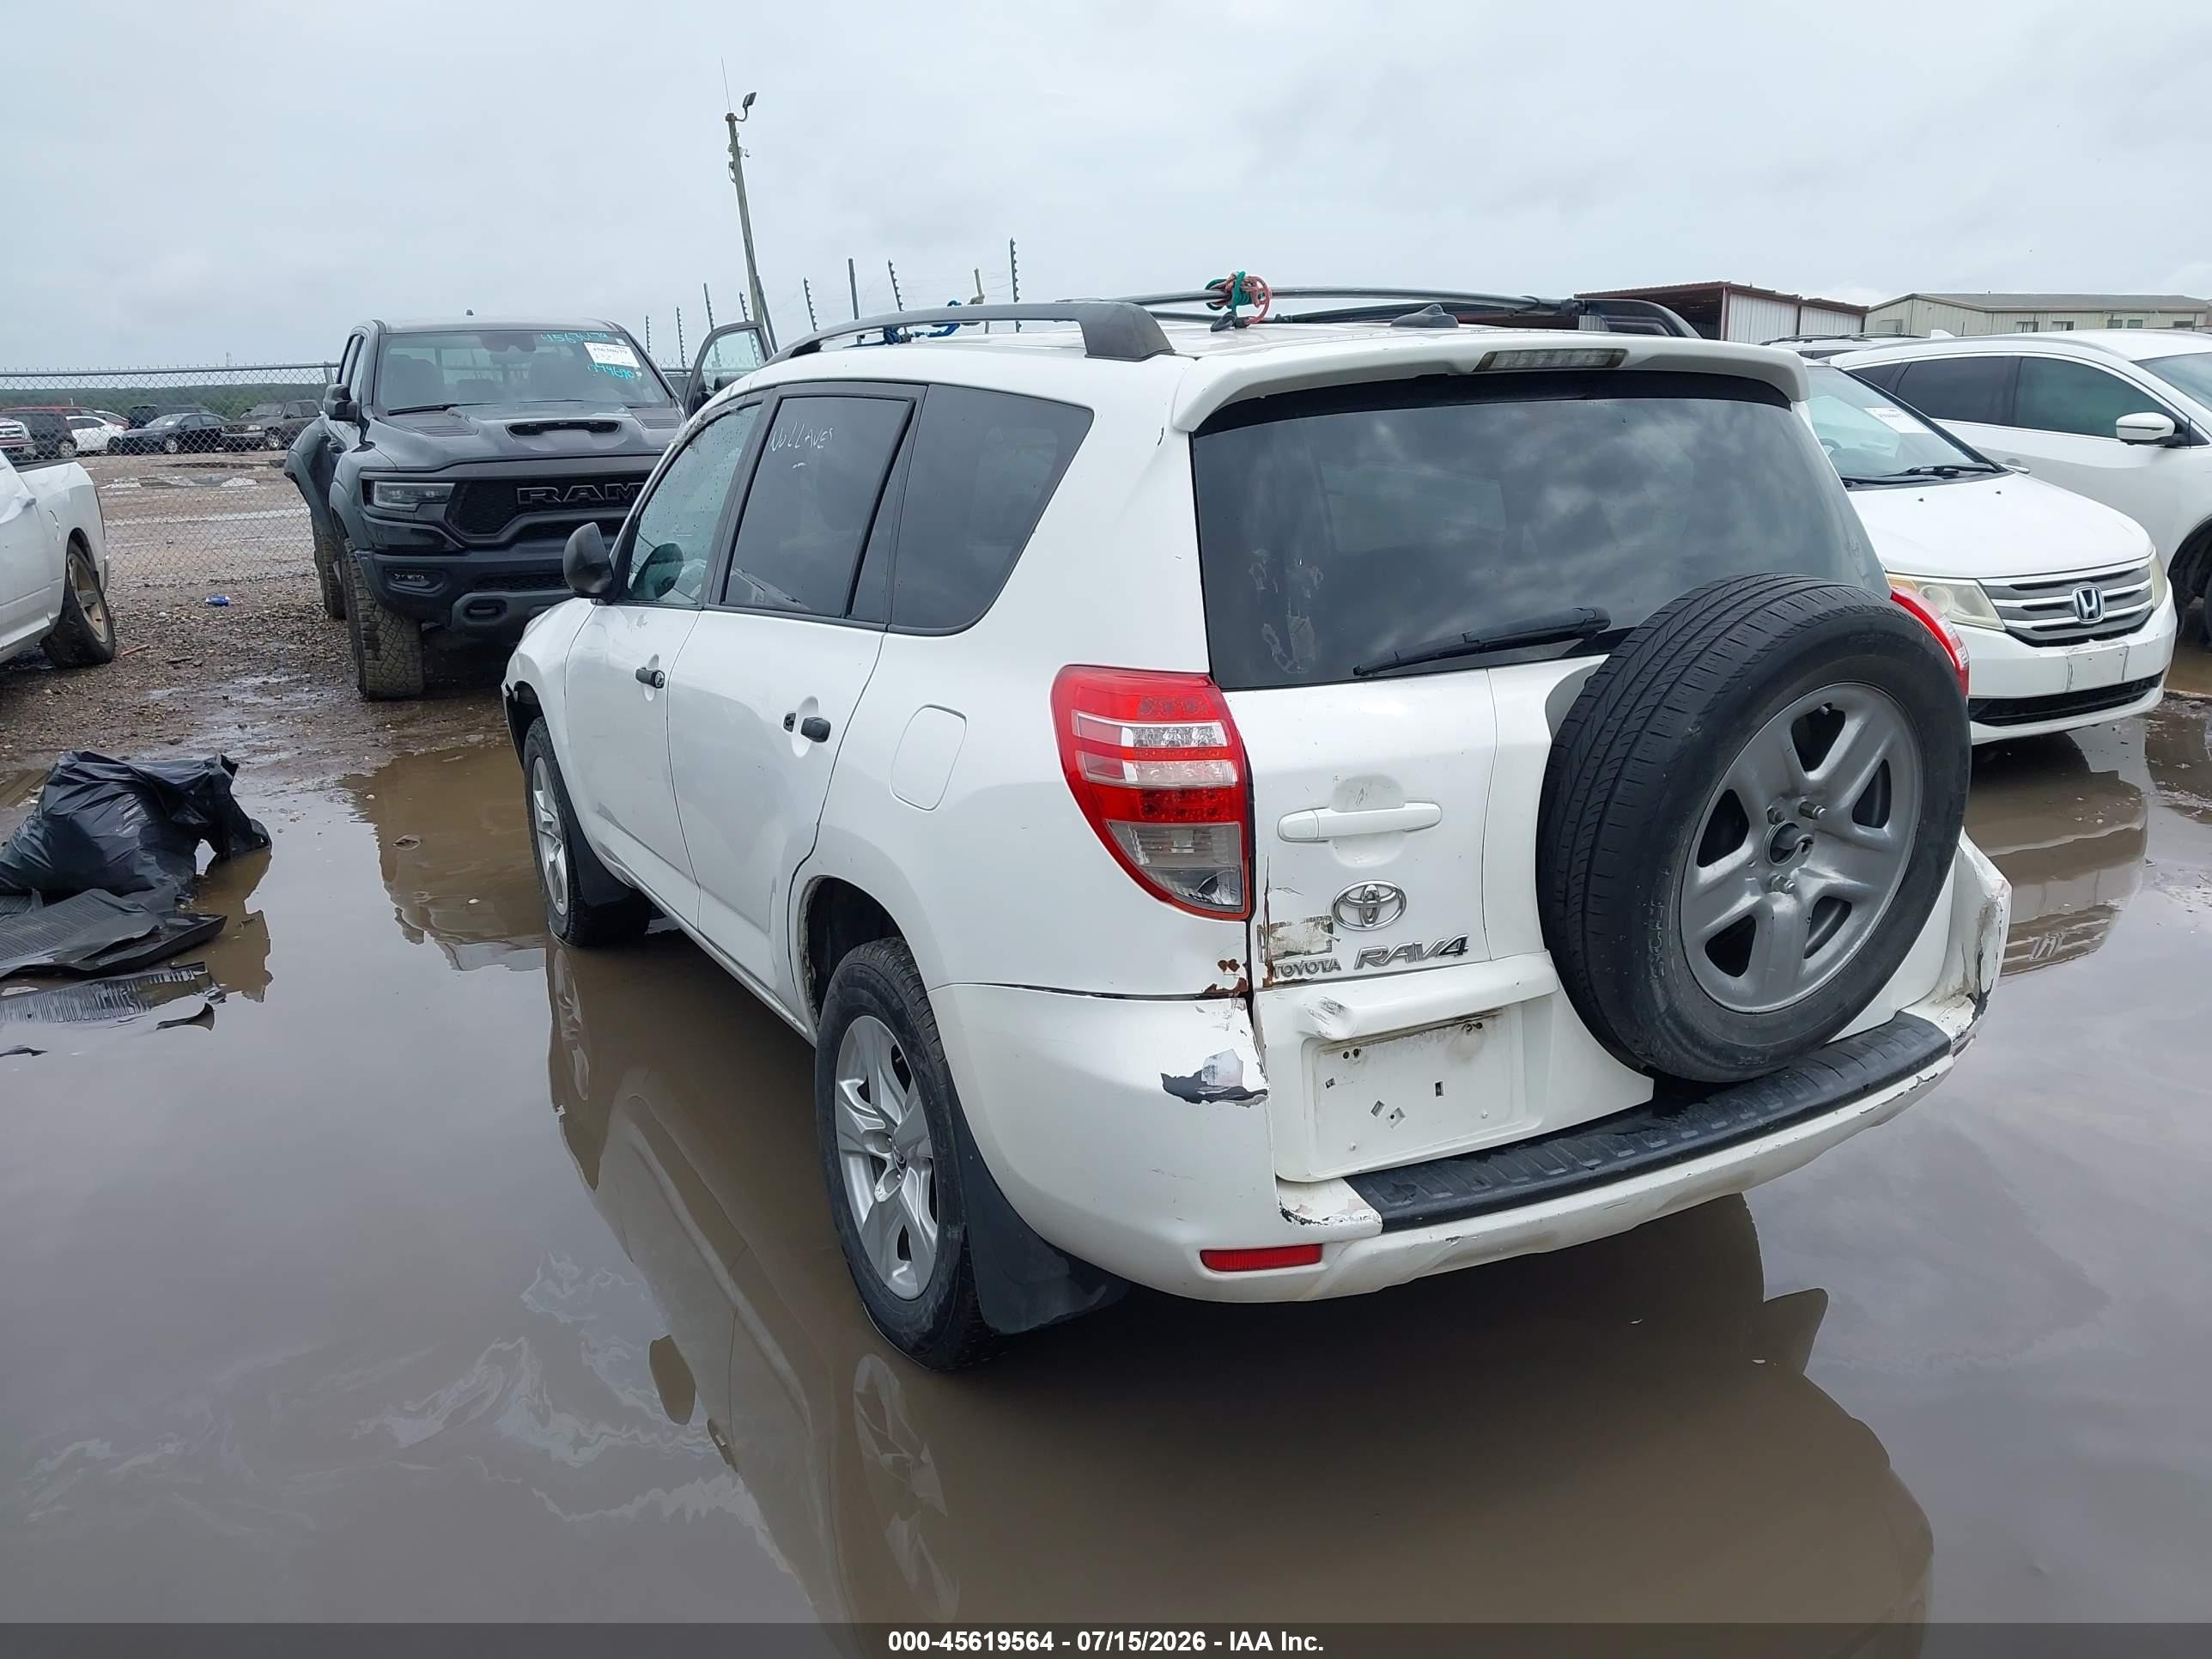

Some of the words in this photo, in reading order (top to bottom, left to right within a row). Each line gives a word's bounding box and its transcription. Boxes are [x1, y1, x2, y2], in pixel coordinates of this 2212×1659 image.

[517, 483, 644, 504] RAM
[1353, 933, 1470, 970] RAV4
[1273, 957, 1342, 979] TOYOTA
